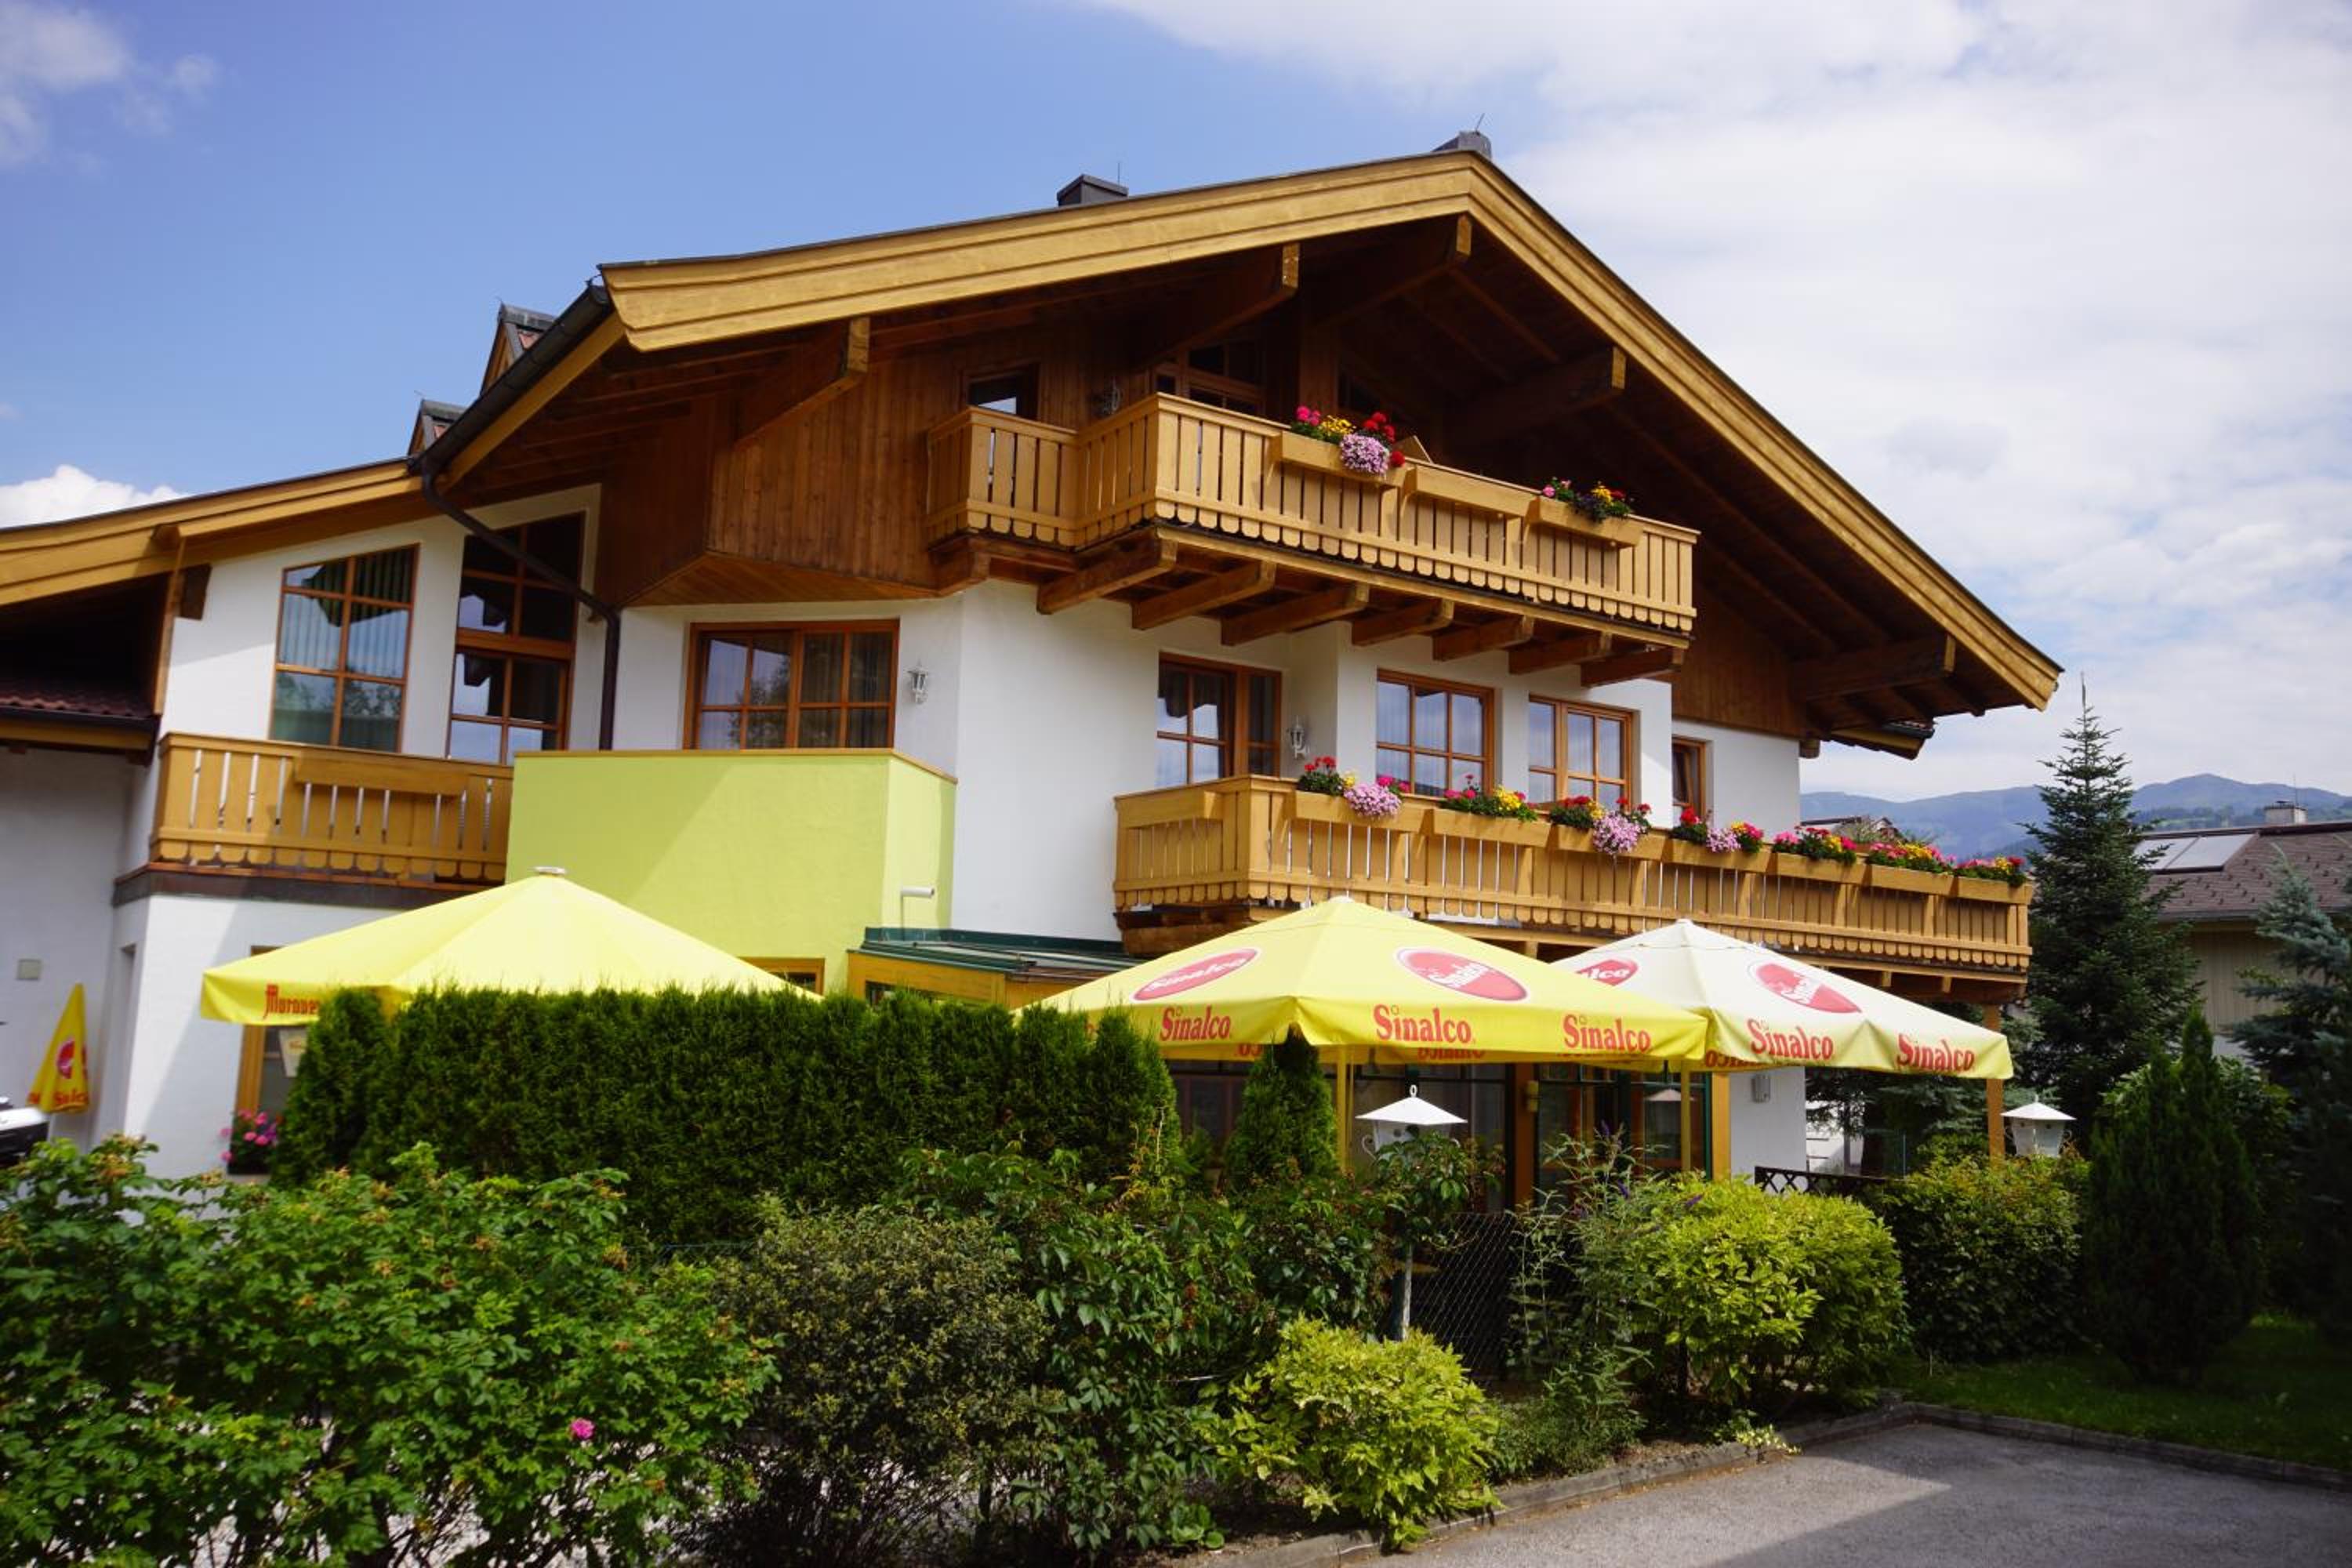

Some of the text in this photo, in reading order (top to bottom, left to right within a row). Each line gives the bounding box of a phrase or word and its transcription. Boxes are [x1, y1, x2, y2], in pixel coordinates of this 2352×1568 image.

[1160, 1005, 1231, 1041] Sinalco
[1373, 1004, 1472, 1044] Sinalco
[1563, 1014, 1652, 1054] Sinalco
[1747, 1018, 1833, 1062] Sinalco
[1896, 1033, 1975, 1072] Sinalco
